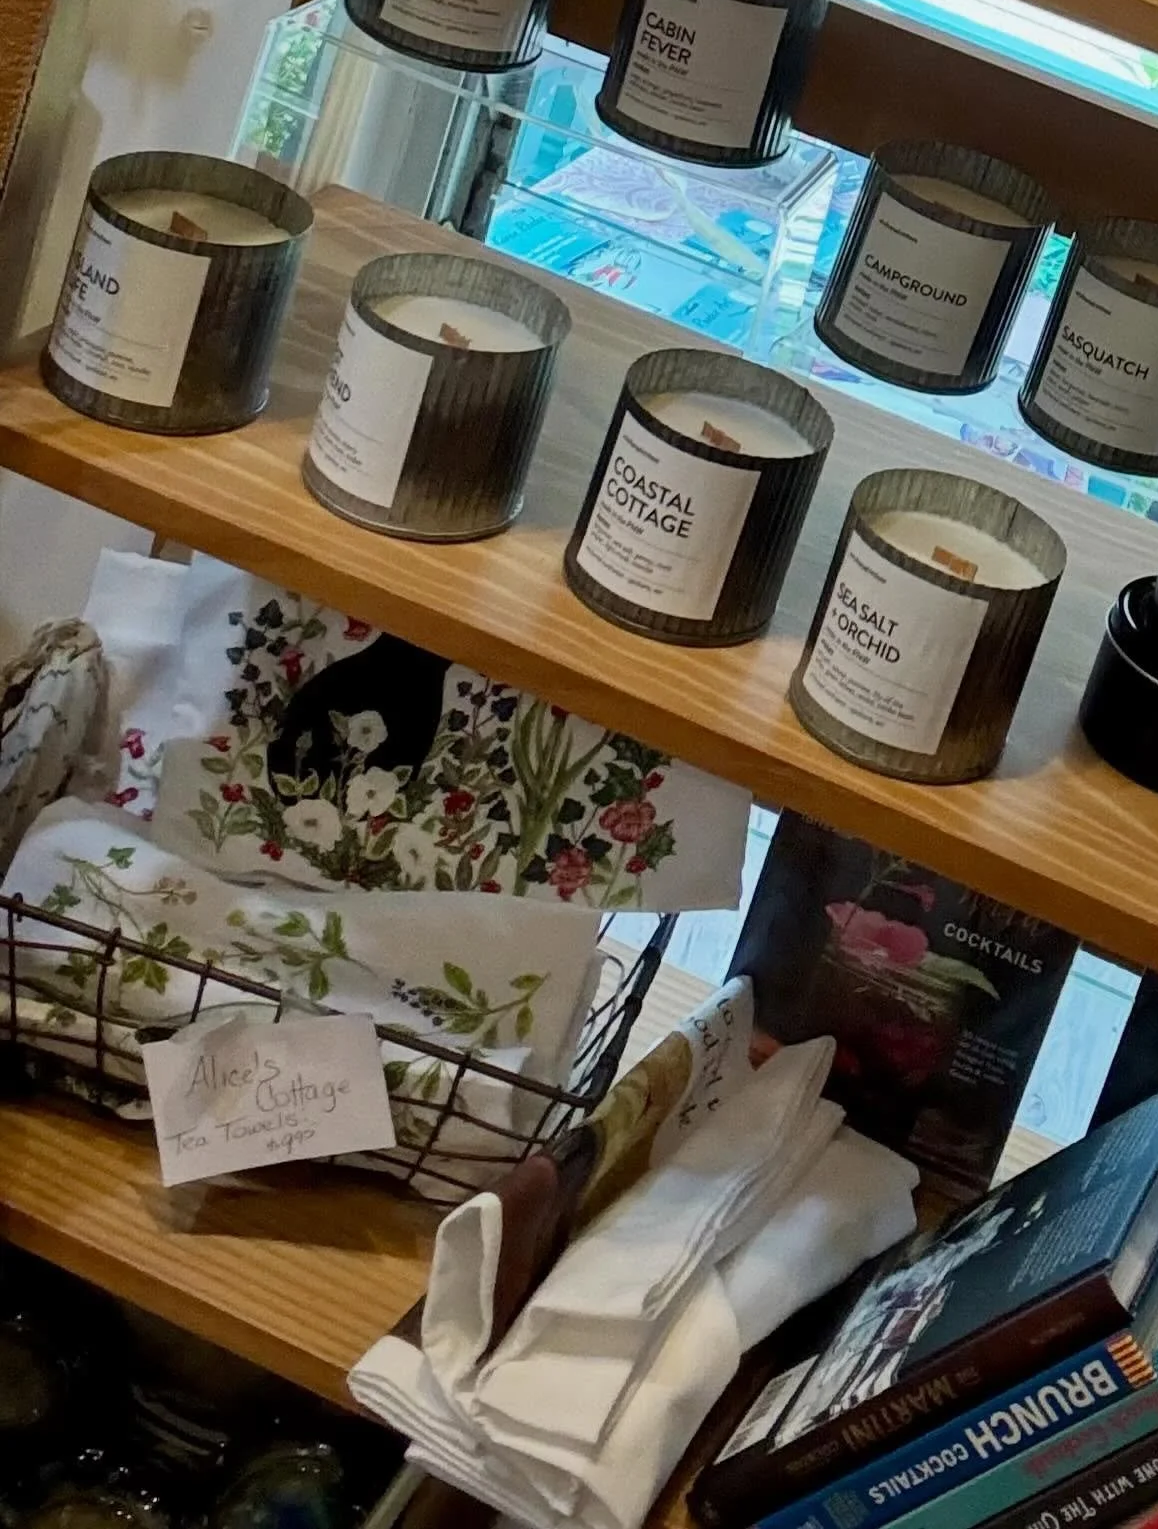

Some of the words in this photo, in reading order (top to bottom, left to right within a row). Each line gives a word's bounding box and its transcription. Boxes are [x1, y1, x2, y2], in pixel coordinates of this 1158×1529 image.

[640, 29, 693, 65] FEVER
[645, 11, 697, 46] CABIN
[864, 253, 968, 308] CAMPGROUND
[1061, 325, 1150, 381] SASQUATCH
[607, 477, 694, 538] COTTAGE
[614, 455, 696, 517] COASTAL
[836, 582, 859, 614] SEA
[858, 603, 900, 637] SALT
[837, 613, 901, 664] ORCHID
[943, 922, 1044, 974] COCKTAILS
[185, 1051, 281, 1098] Alice's
[255, 1074, 352, 1114] Cottage
[164, 1124, 209, 1155] Tea
[840, 1374, 958, 1452] MARTINI
[965, 1359, 1119, 1459] BRUNCH
[868, 1441, 970, 1506] COCKTAILS
